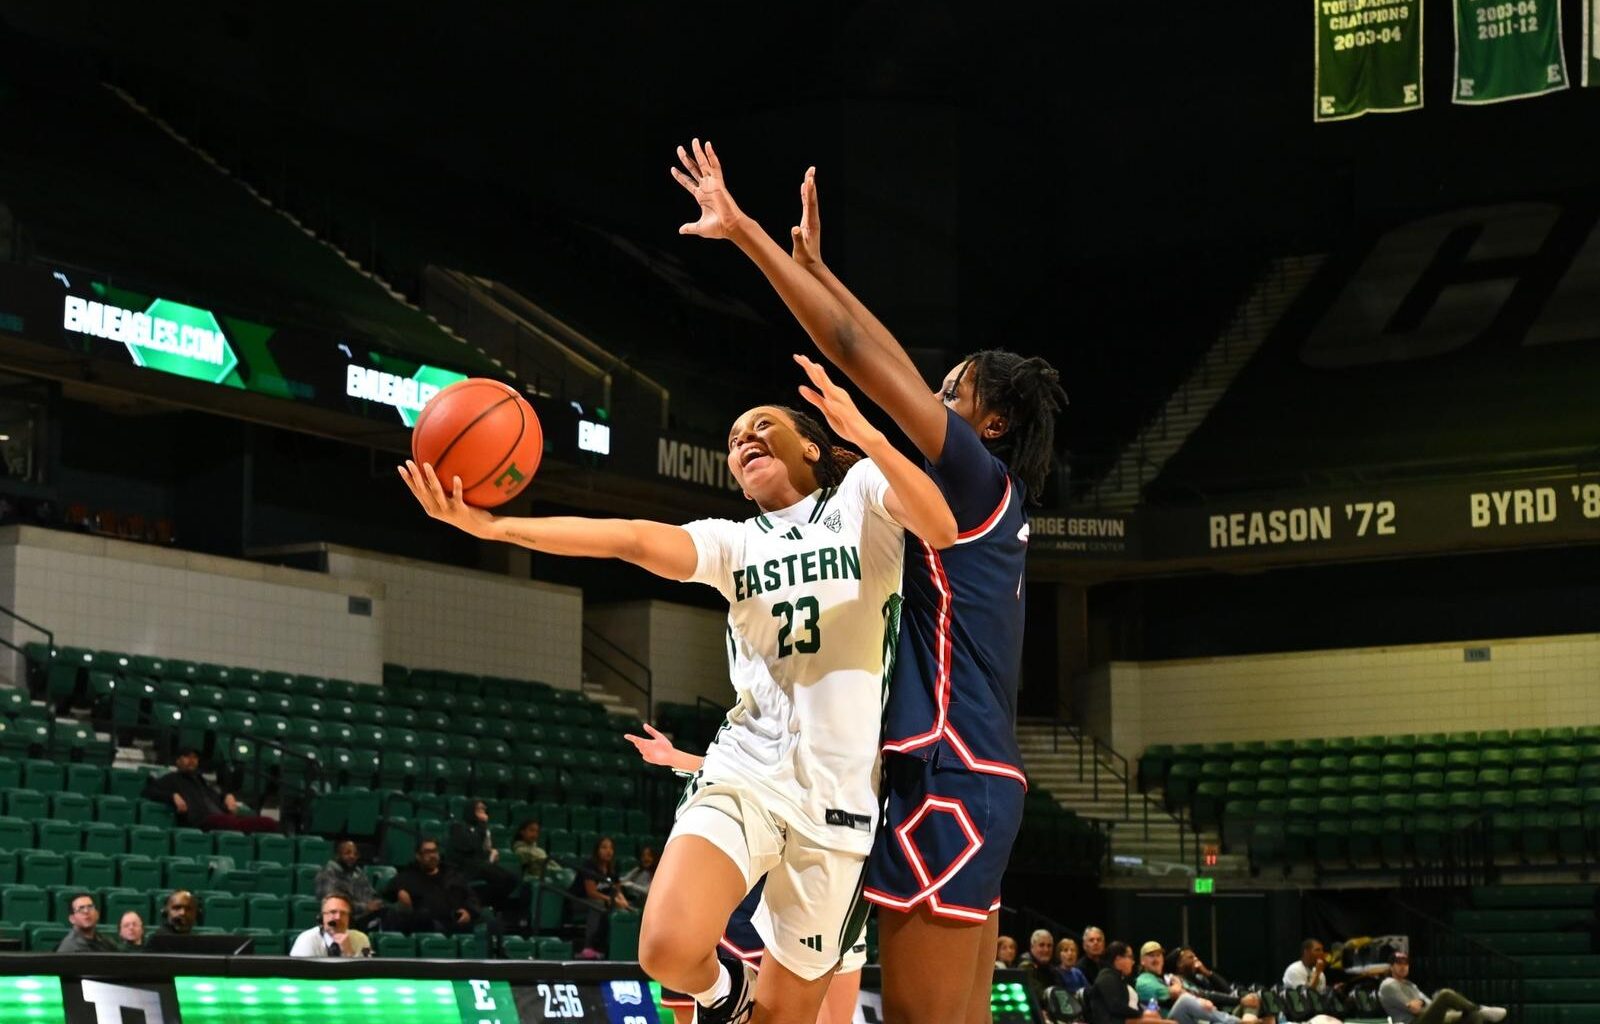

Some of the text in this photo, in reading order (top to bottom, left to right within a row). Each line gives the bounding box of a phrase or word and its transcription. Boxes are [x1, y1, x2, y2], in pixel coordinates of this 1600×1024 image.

[1330, 6, 1408, 30] CHAMPIONS
[1476, 0, 1537, 23] 2003-04
[1333, 25, 1402, 51] 2003-04
[1478, 16, 1538, 40] 2011-12
[1546, 64, 1562, 84] E
[1403, 84, 1418, 104] E
[1460, 78, 1475, 97] E
[1320, 96, 1336, 115] E
[347, 364, 441, 412] EMUEAGLE
[1471, 487, 1557, 528] BYRD
[1028, 517, 1066, 536] ORGE
[1067, 517, 1125, 537] GERVIN
[1209, 501, 1396, 548] REASON '72
[733, 545, 862, 602] EASTERN
[772, 595, 821, 659] 23
[468, 979, 497, 1011] E
[537, 984, 585, 1018] 2:56
